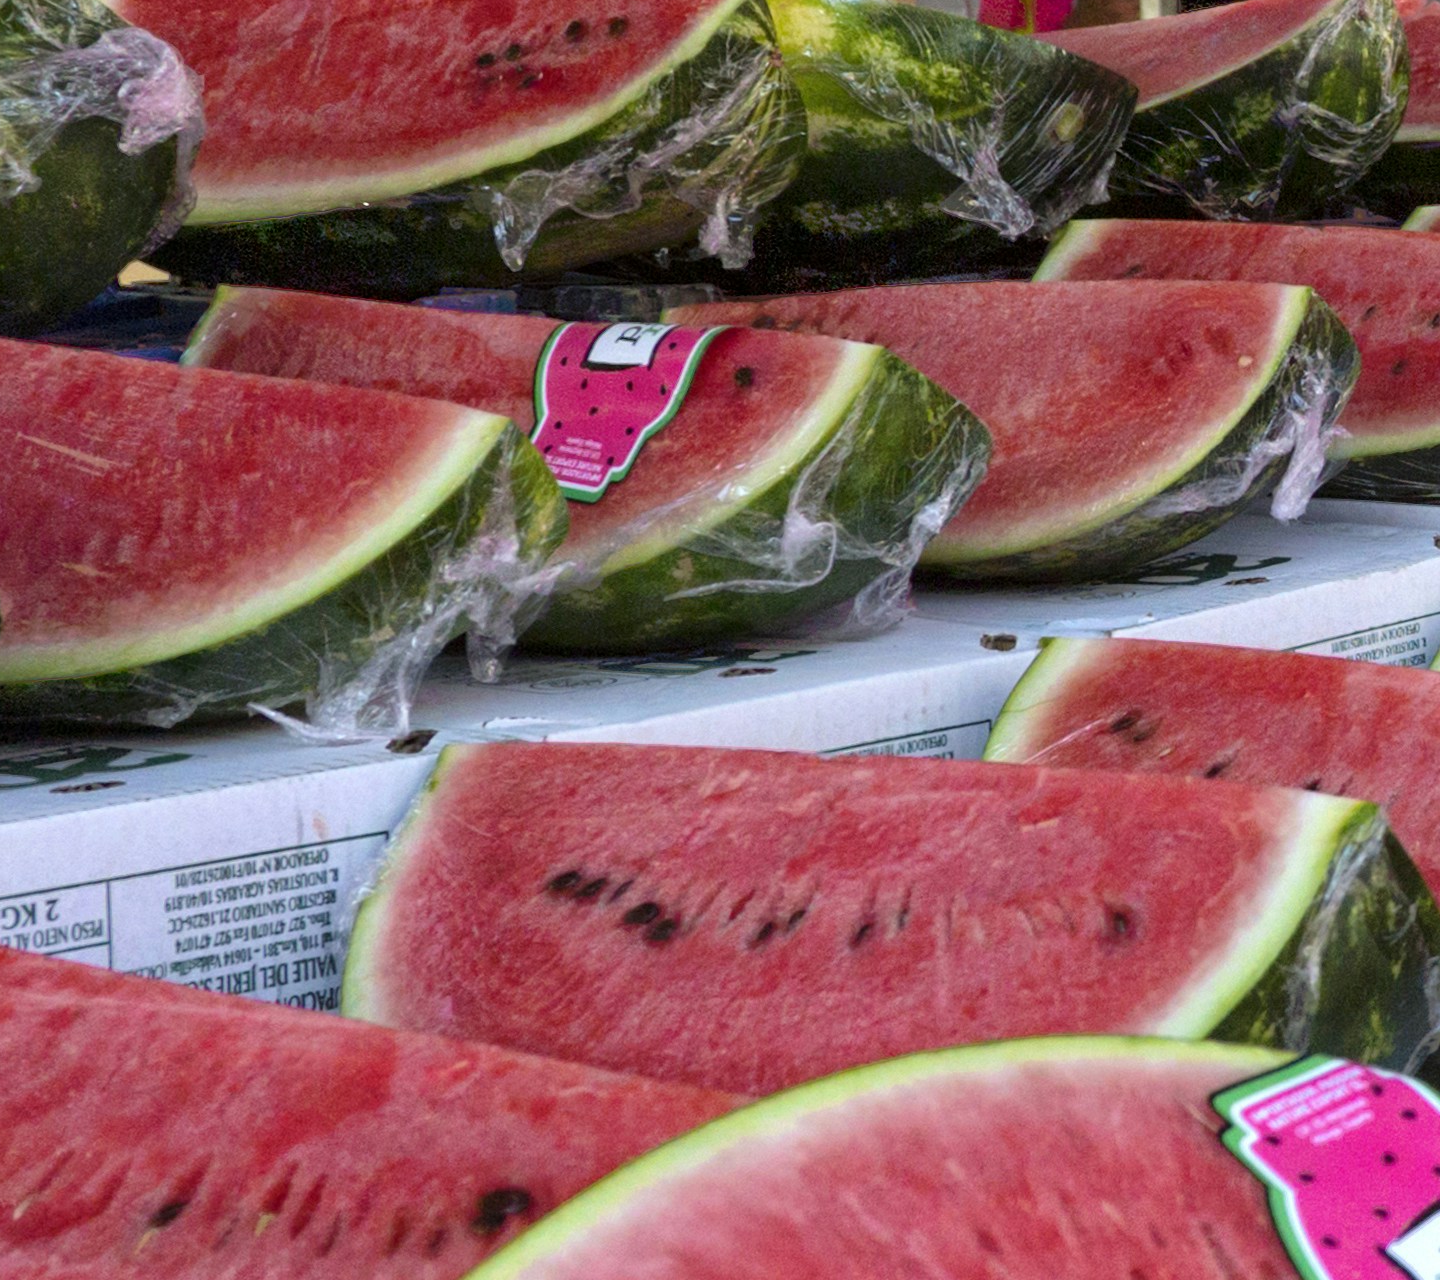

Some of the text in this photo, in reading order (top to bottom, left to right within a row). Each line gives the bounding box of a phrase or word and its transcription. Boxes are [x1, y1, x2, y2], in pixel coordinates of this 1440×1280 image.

[274, 848, 329, 871] OPERADOR
[216, 880, 265, 903] AGRARIAS
[268, 870, 328, 894] INDUSTRIAS
[45, 899, 60, 922] 2
[233, 898, 286, 922] SANITARIO
[289, 889, 337, 912] REGISTRO
[32, 926, 68, 949] NETO
[71, 919, 103, 941] PESO
[233, 926, 249, 941] Fax
[260, 963, 288, 989] DEL
[293, 953, 337, 984] VALLE
